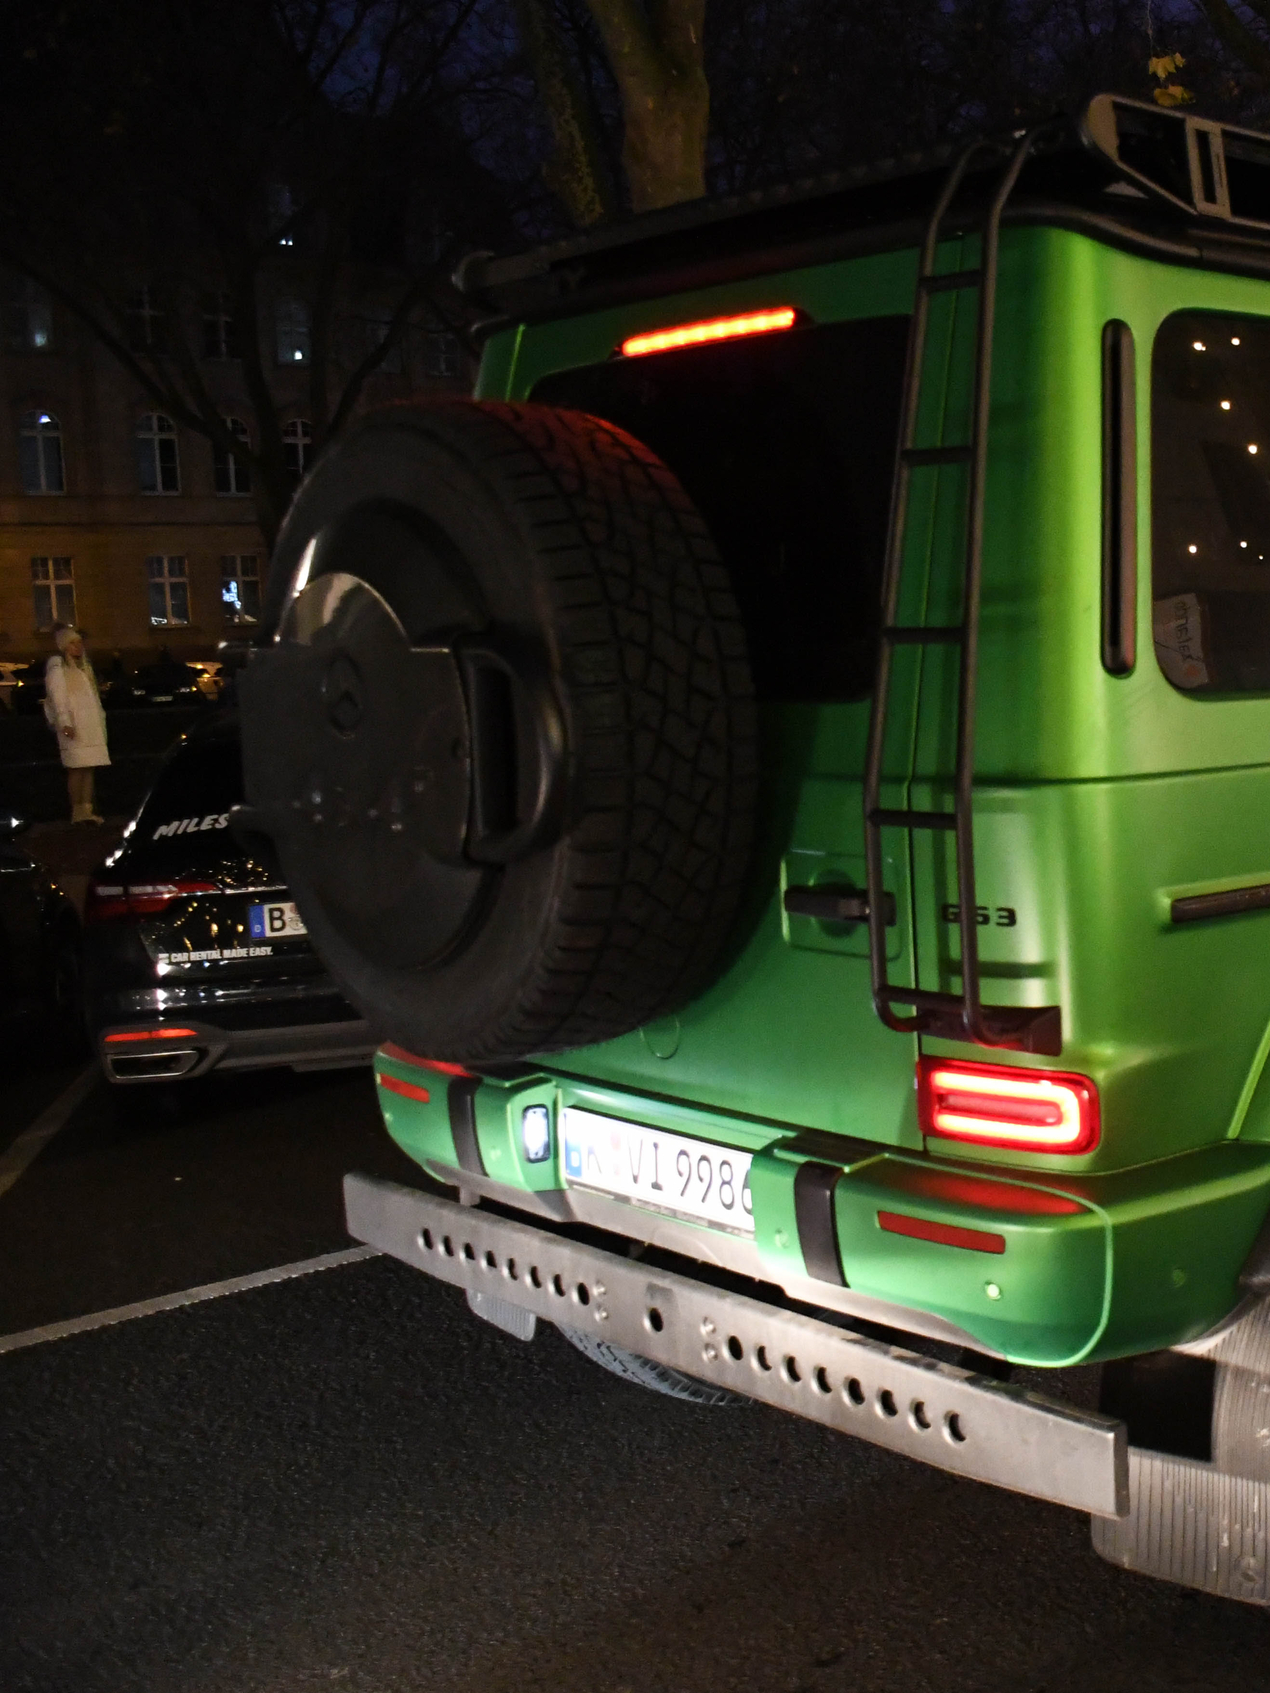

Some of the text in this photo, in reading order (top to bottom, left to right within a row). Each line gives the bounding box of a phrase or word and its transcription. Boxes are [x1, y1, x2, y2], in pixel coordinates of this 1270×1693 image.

[153, 813, 229, 840] MILES
[268, 907, 286, 932] B
[171, 946, 274, 963] CAR RENTAL MADE EASY.
